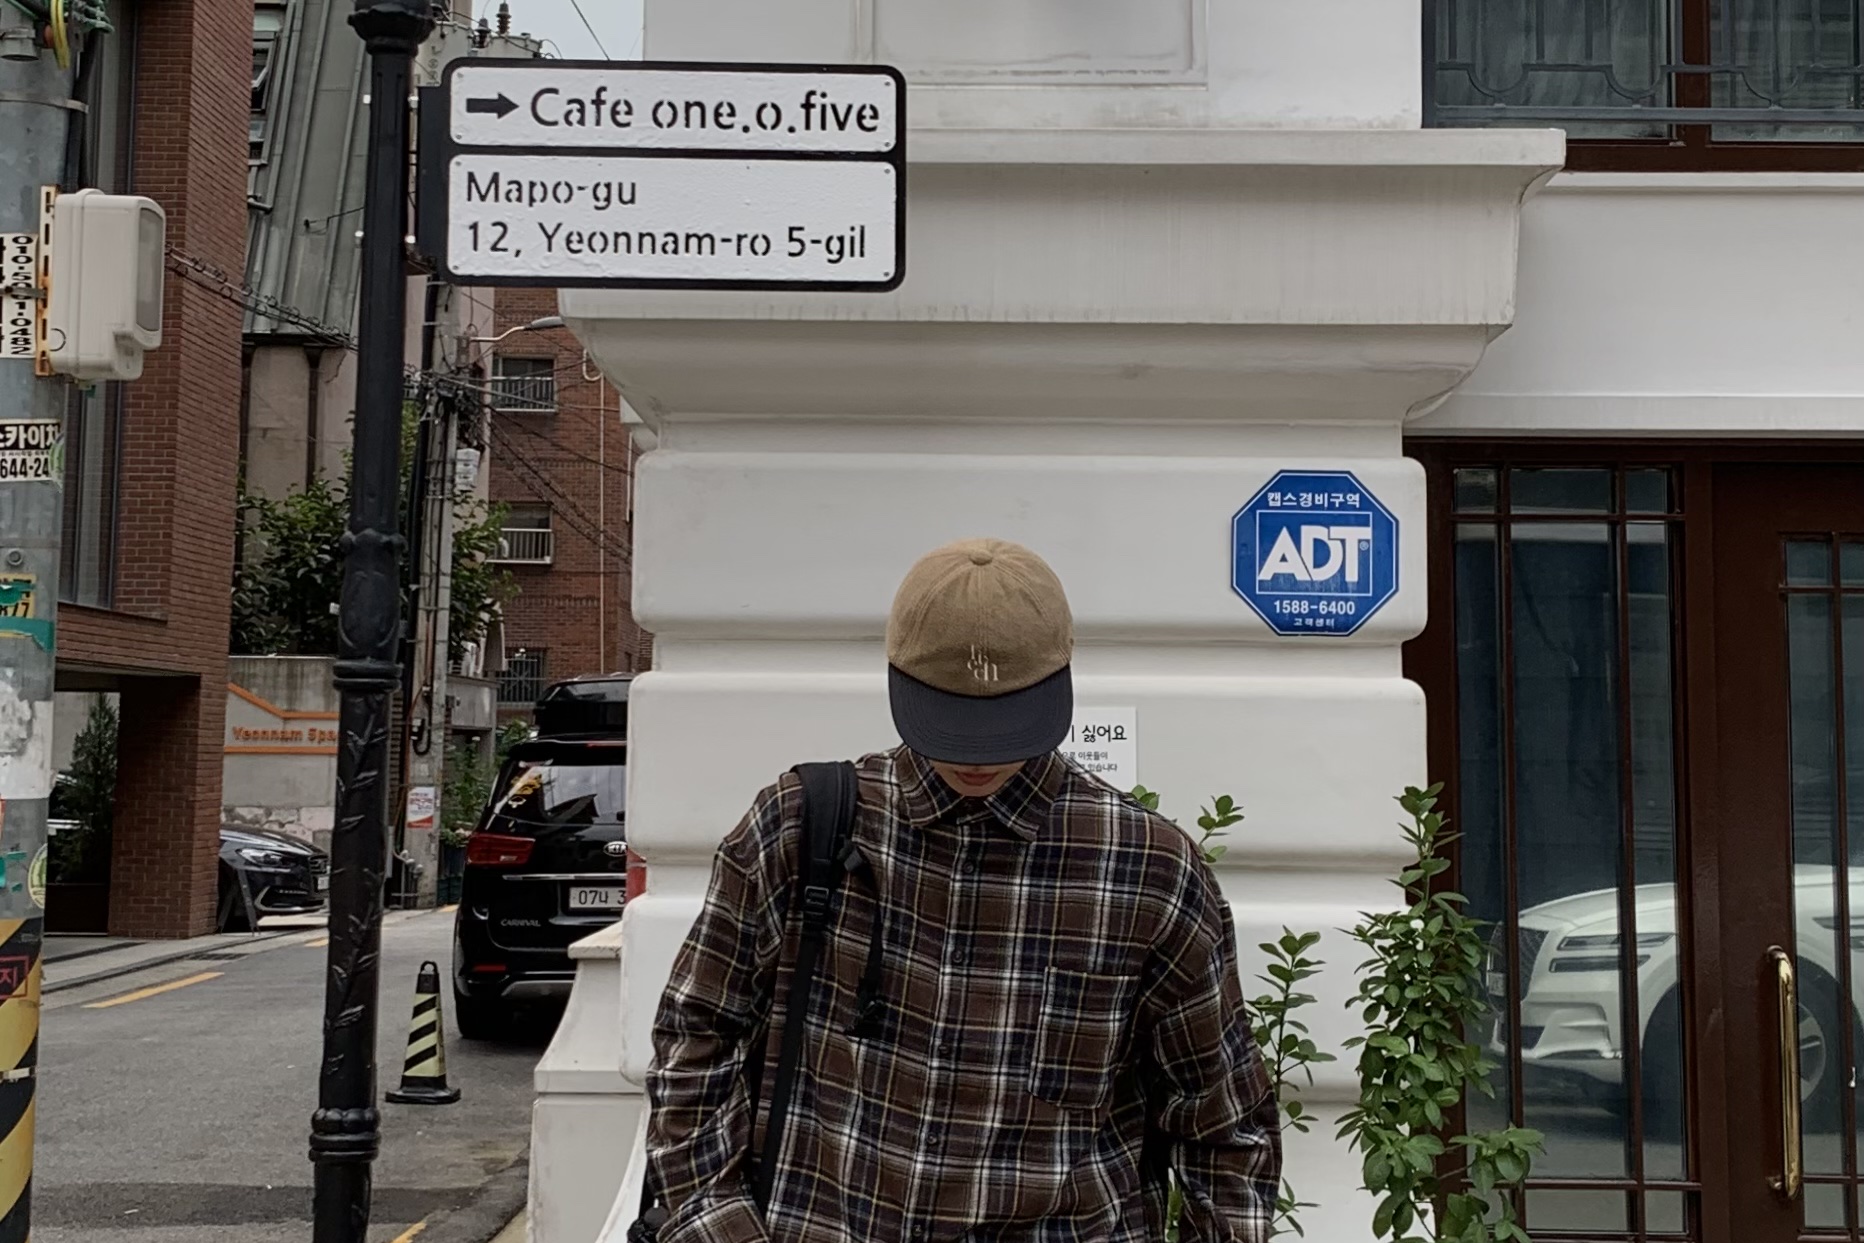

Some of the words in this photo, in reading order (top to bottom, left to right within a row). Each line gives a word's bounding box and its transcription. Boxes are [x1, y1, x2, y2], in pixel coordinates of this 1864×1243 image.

[530, 86, 634, 128] Cafe
[651, 90, 880, 134] one.o.five
[466, 171, 637, 211] Mapo-gu
[468, 221, 522, 258] 12,
[537, 222, 771, 257] Yeonnam-ro
[787, 225, 866, 264] 5-gil
[1266, 491, 1361, 508] 캡스경비구역
[1257, 524, 1371, 583] ADT
[1273, 600, 1356, 615] 1588-6400
[1293, 618, 1335, 628] 고객센터
[1081, 724, 1128, 743] 싫어요
